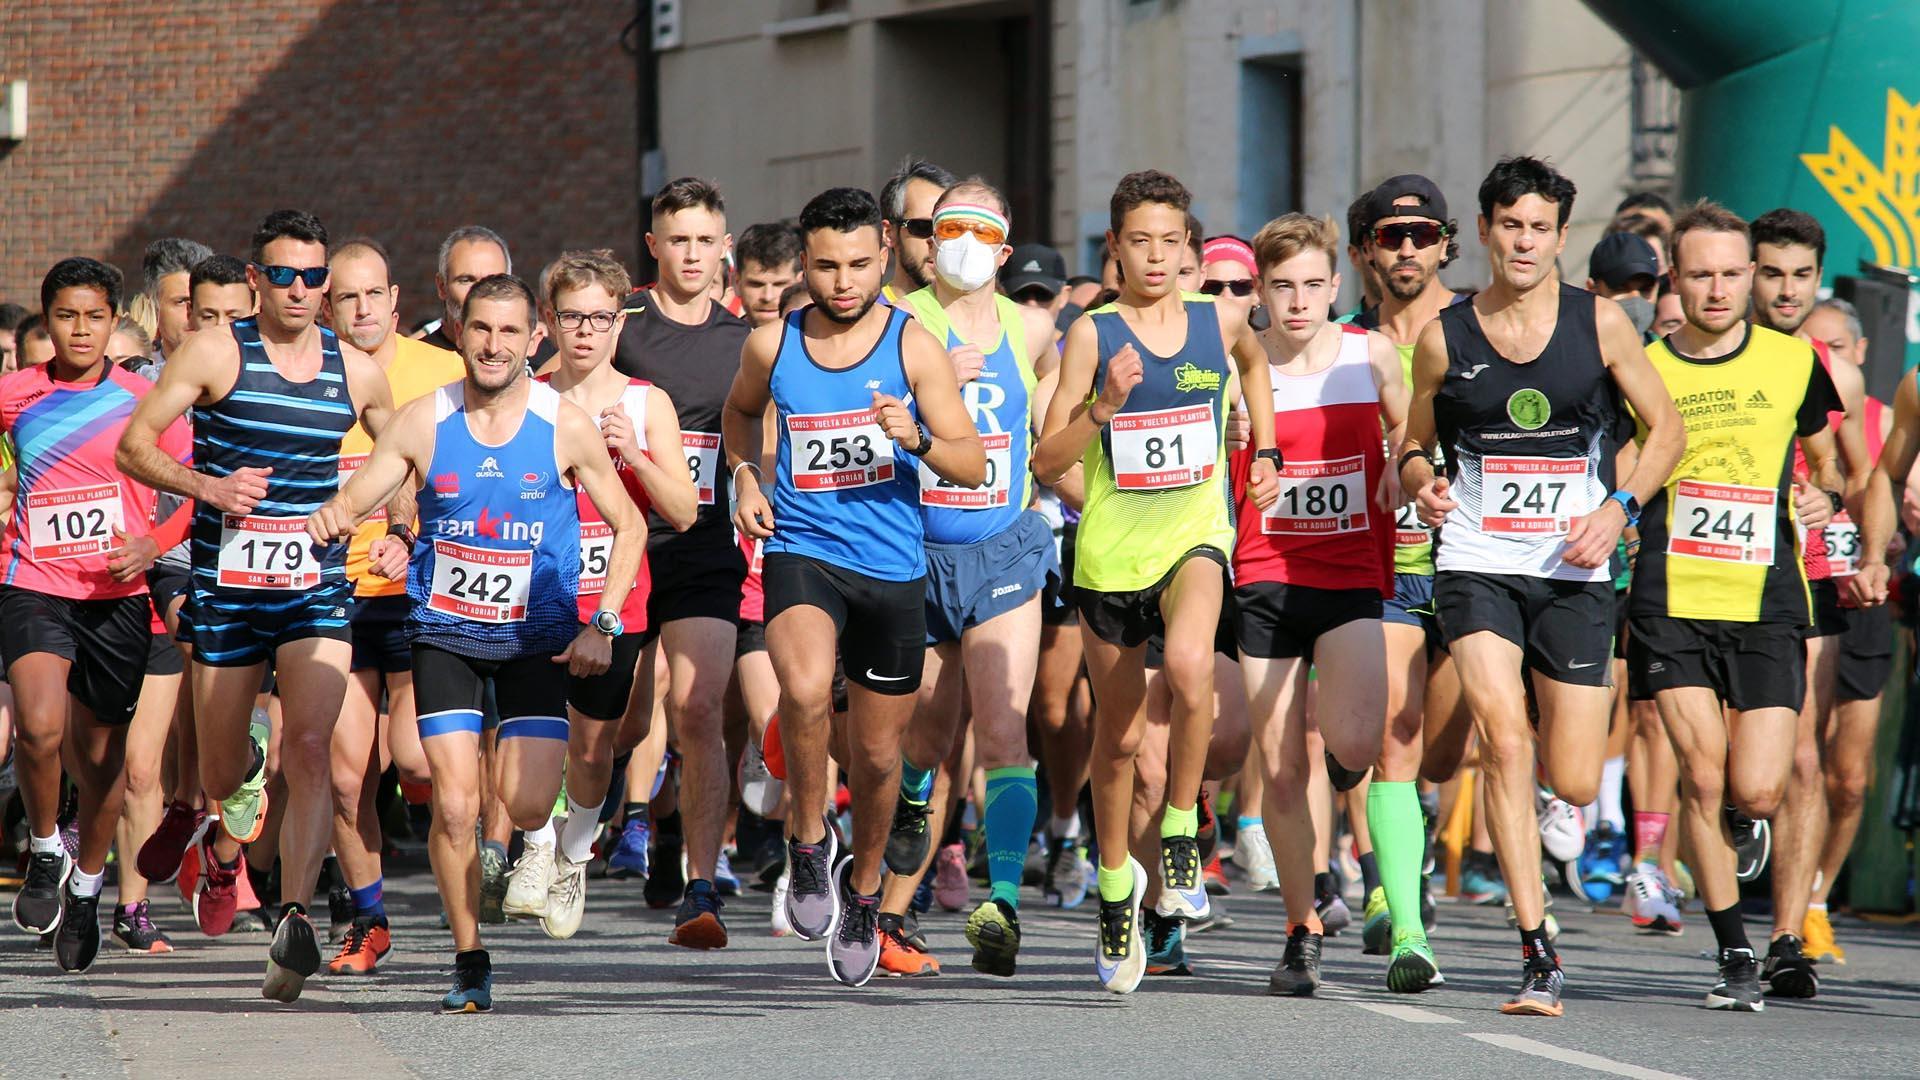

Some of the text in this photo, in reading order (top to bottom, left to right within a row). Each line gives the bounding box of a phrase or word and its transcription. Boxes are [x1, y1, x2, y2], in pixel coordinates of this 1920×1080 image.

[791, 420, 809, 429] CROSS
[842, 417, 851, 426] AL
[1114, 420, 1136, 429] CROSS
[1171, 415, 1178, 423] AL
[806, 435, 874, 471] 253
[1145, 433, 1185, 469] 81
[1485, 463, 1507, 471] CROSS
[1541, 463, 1549, 471] AL
[819, 476, 833, 485] SAN
[1146, 476, 1160, 484] SAN
[520, 489, 546, 500] ardoi
[946, 494, 960, 502] SAN
[1500, 482, 1567, 514] 247
[1679, 485, 1699, 495] CROSS
[1732, 491, 1741, 499] AL
[30, 496, 48, 507] CROSS
[77, 492, 86, 501] AL
[1284, 483, 1348, 516] 180
[47, 508, 107, 541] 102
[280, 523, 287, 531] AL
[1511, 521, 1526, 529] SAN
[1689, 506, 1755, 543] 244
[591, 529, 599, 537] AL
[58, 545, 72, 554] SAN
[241, 539, 303, 570] 179
[438, 544, 457, 556] CROSS
[1697, 544, 1712, 553] SAN
[448, 566, 512, 604] 242
[456, 603, 468, 613] SAN
